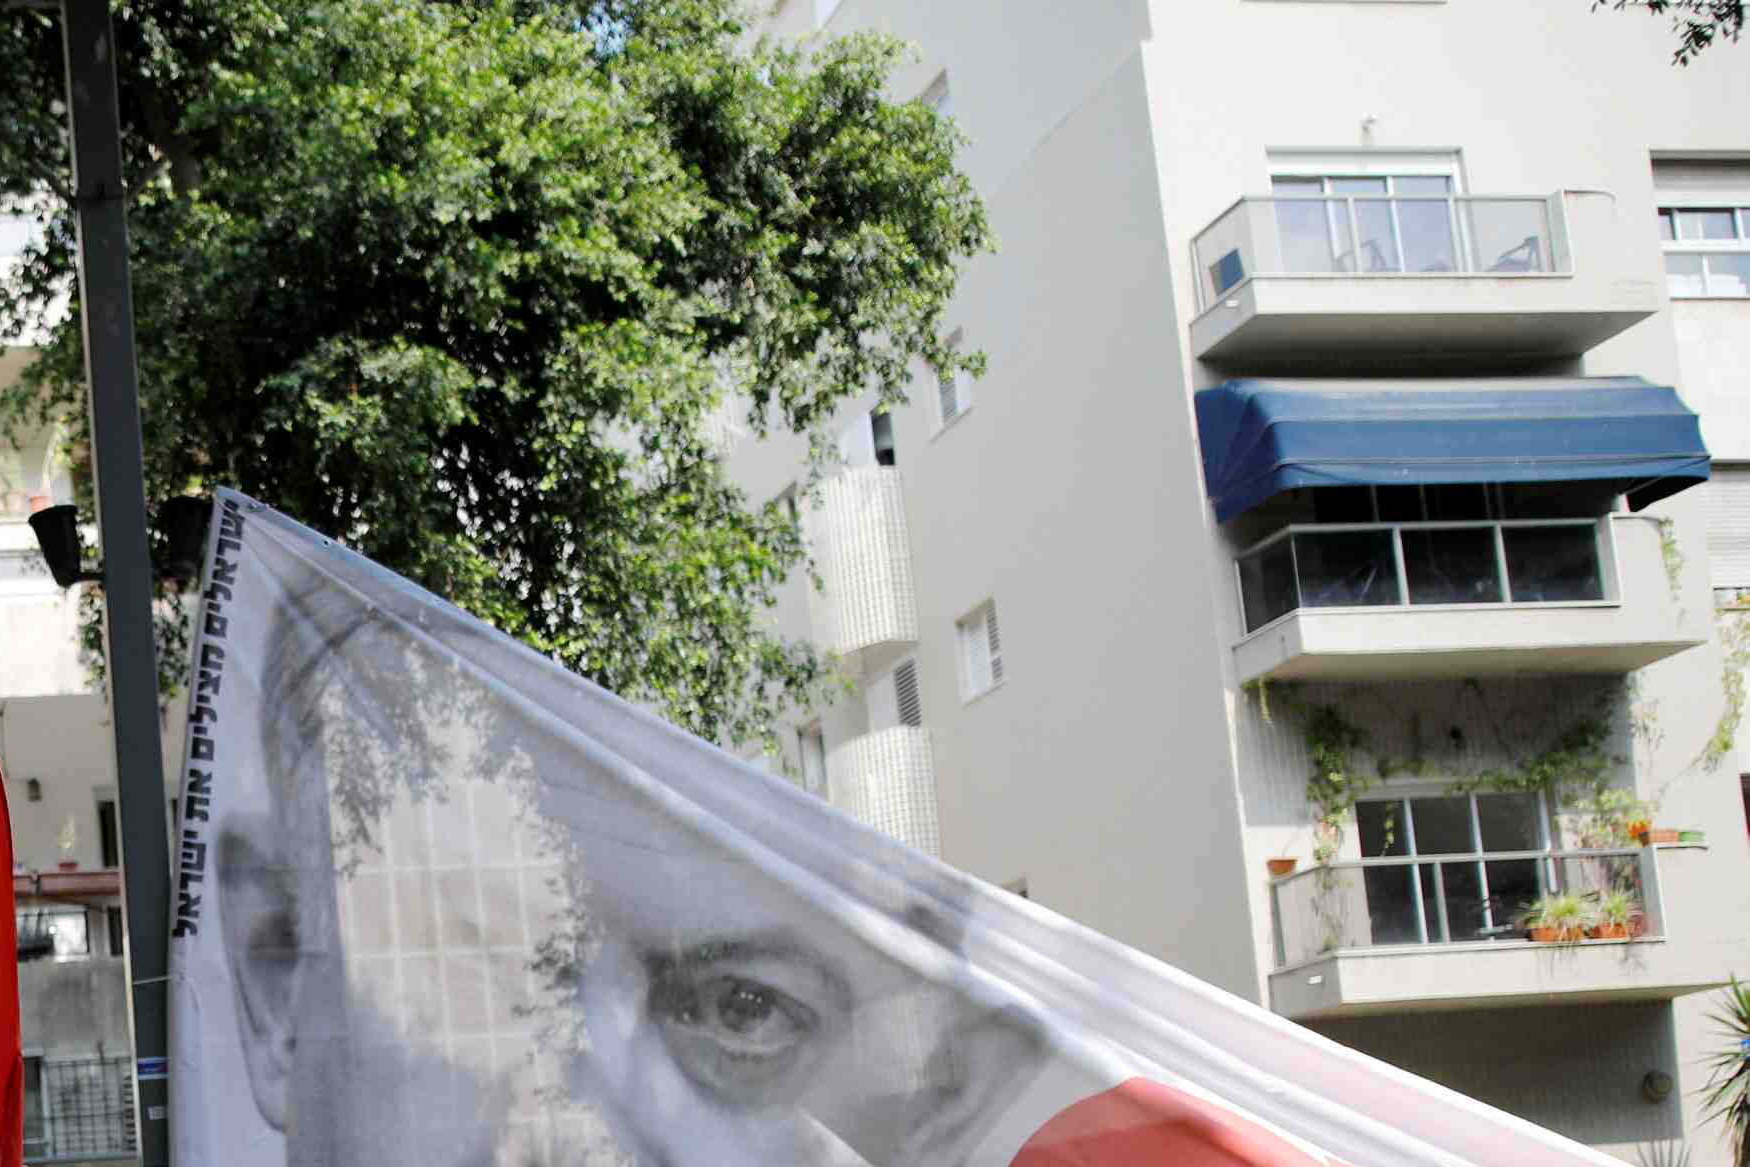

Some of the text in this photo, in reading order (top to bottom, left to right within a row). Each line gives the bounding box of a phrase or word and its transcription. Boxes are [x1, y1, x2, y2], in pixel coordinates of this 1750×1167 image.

[189, 643, 227, 764] מצילים
[185, 768, 213, 823] את
[173, 831, 208, 940] ישראל
